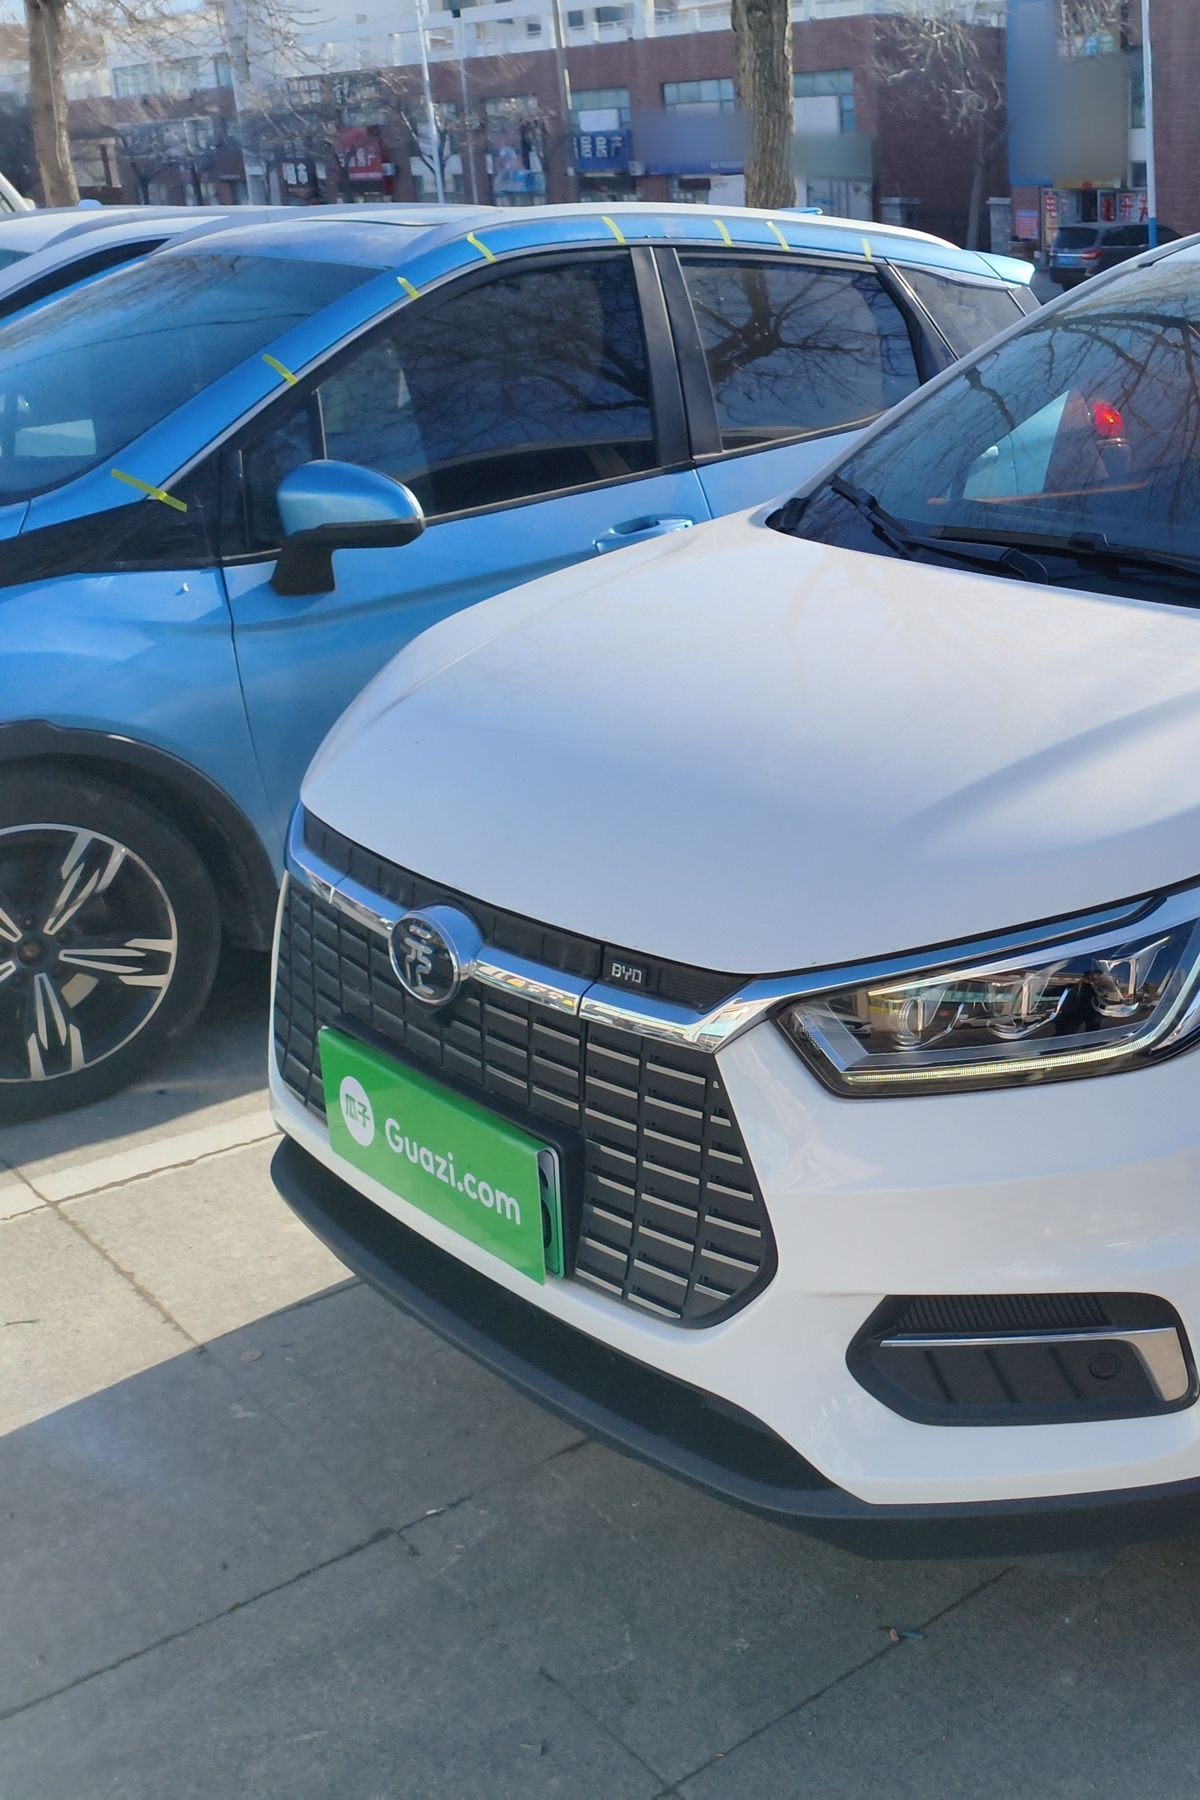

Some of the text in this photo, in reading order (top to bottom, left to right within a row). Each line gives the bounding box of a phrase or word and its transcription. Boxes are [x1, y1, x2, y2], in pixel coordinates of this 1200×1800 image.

[611, 962, 642, 984] BYD
[344, 1092, 370, 1128] 瓜子
[384, 1117, 521, 1226] Guazi.com
